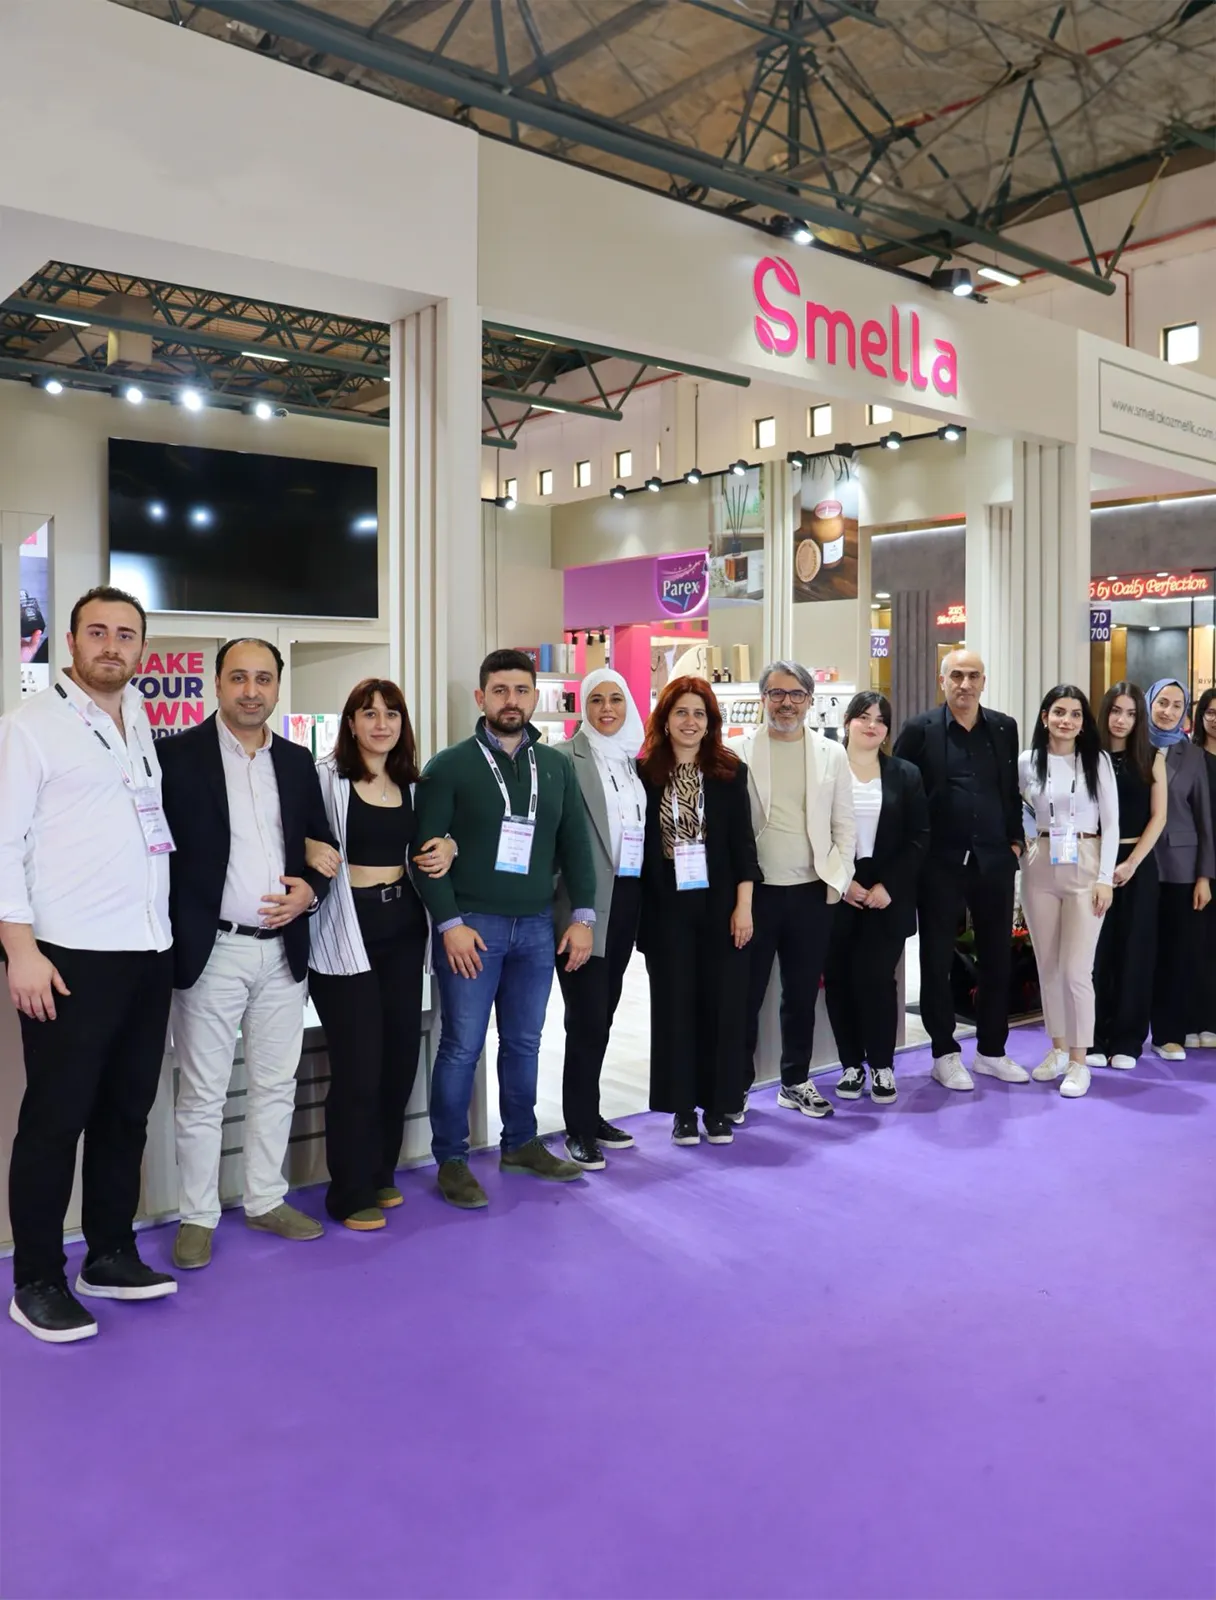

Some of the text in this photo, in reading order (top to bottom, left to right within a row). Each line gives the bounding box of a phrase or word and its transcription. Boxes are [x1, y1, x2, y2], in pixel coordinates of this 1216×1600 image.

[754, 256, 957, 399] Smella
[663, 580, 699, 597] Parex
[1096, 582, 1110, 600] by
[1112, 579, 1144, 598] Daily
[1146, 576, 1207, 596] Perfection
[1093, 612, 1107, 624] 7D
[874, 637, 886, 646] 7D
[1091, 628, 1109, 640] 700
[872, 648, 888, 657] 700
[136, 653, 204, 674] AKE
[144, 701, 204, 726] WN
